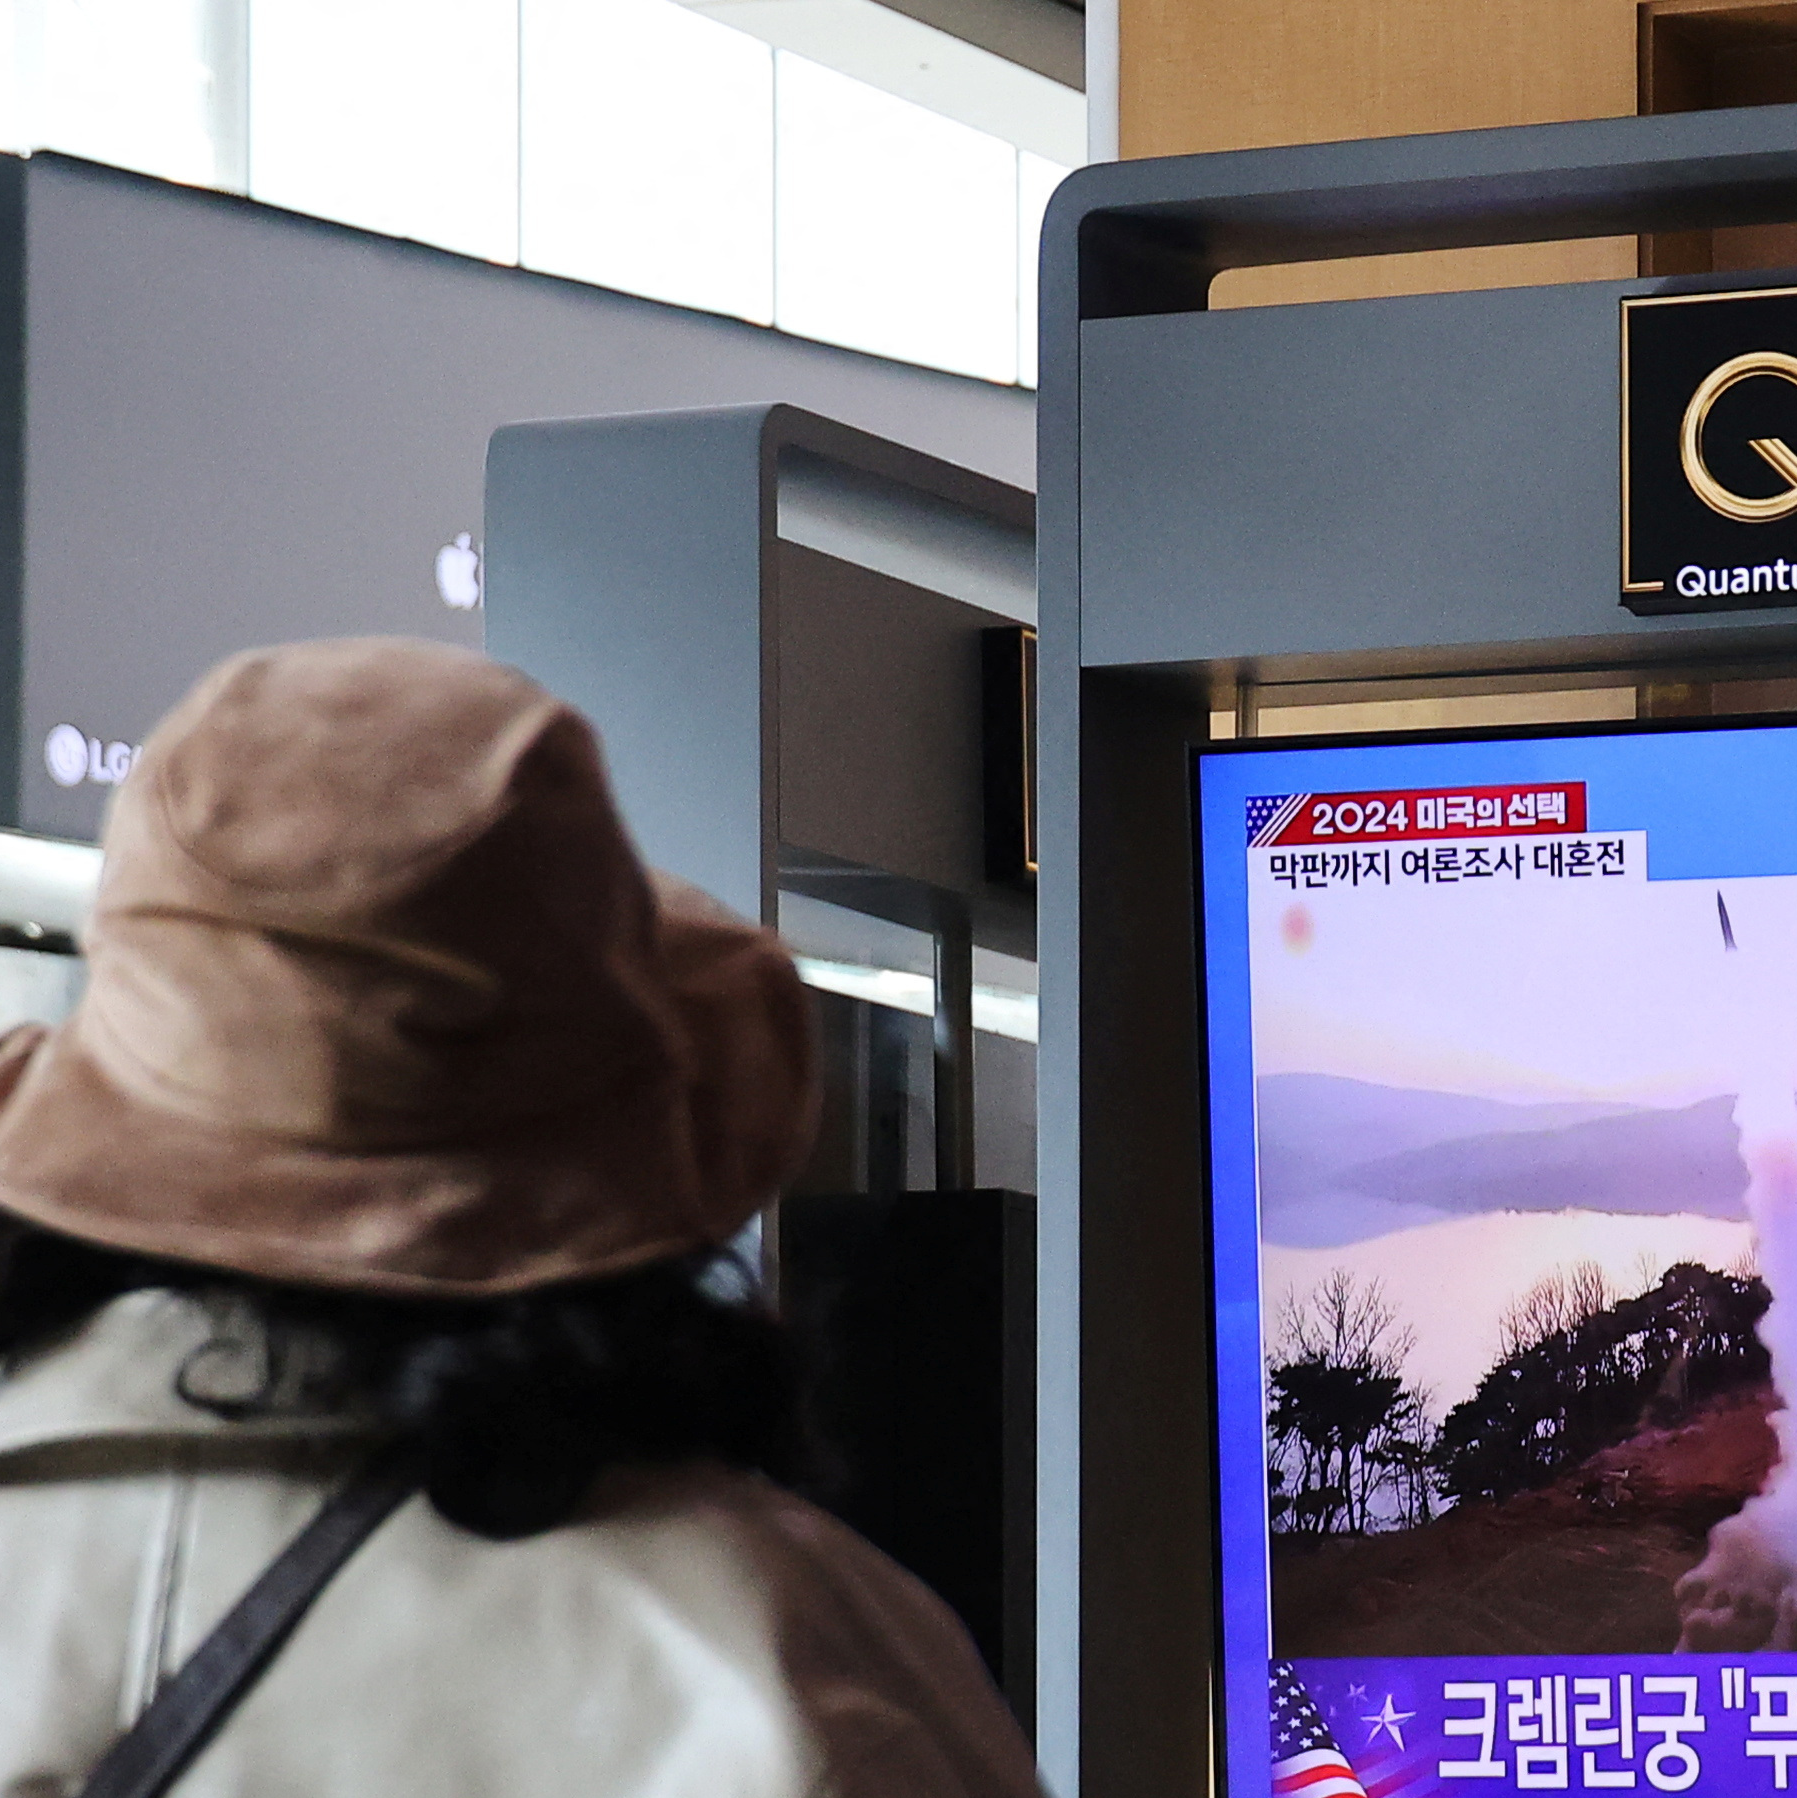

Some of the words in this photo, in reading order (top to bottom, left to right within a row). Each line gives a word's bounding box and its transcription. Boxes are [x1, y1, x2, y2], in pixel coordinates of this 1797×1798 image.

[88, 736, 144, 784] LG
[1312, 799, 1408, 835] 2024
[1416, 794, 1502, 831] 미국의
[1507, 791, 1567, 827] 선택
[1269, 848, 1391, 890] 막판까지
[1401, 844, 1525, 883] 여론조사
[1533, 838, 1626, 878] 대혼전
[1437, 1674, 1706, 1792] 크렘린궁
